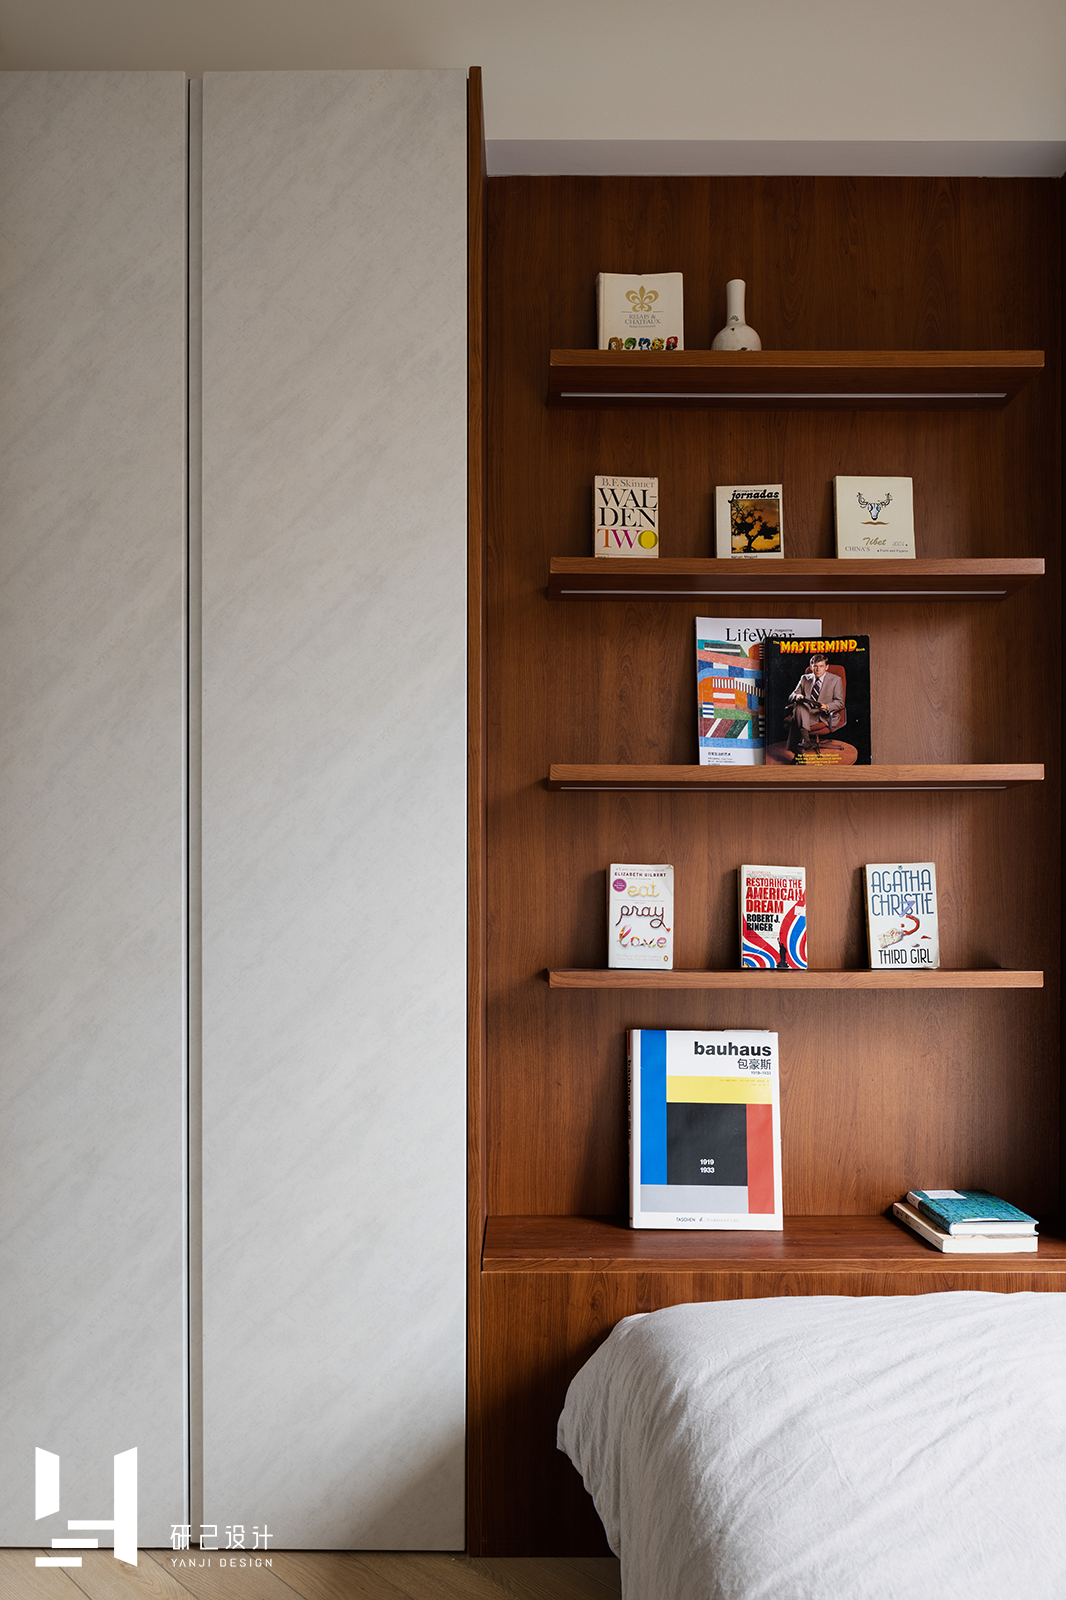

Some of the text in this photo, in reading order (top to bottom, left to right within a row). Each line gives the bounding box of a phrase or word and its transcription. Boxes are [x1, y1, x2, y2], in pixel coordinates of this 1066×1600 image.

[620, 479, 655, 488] Skinner
[597, 488, 658, 508] WAL-
[728, 489, 779, 503] jornadas
[598, 507, 658, 528] DEN
[597, 529, 658, 549] TWO
[863, 537, 886, 546] Tibet
[780, 639, 858, 653] MASTERMIND
[746, 878, 802, 888] RESTORING THE
[871, 869, 931, 893] AGATHA
[627, 880, 659, 897] eat
[746, 887, 804, 901] AMERICAN
[746, 900, 784, 914] DREAM
[871, 892, 934, 916] CHRISTIE
[615, 905, 671, 932] pray
[747, 914, 780, 923] ROBERT J.
[747, 922, 773, 932] RINGER
[878, 949, 933, 964] THIRD GIRL
[694, 1041, 772, 1057] bauhaus
[737, 1058, 772, 1070] 包豪斯
